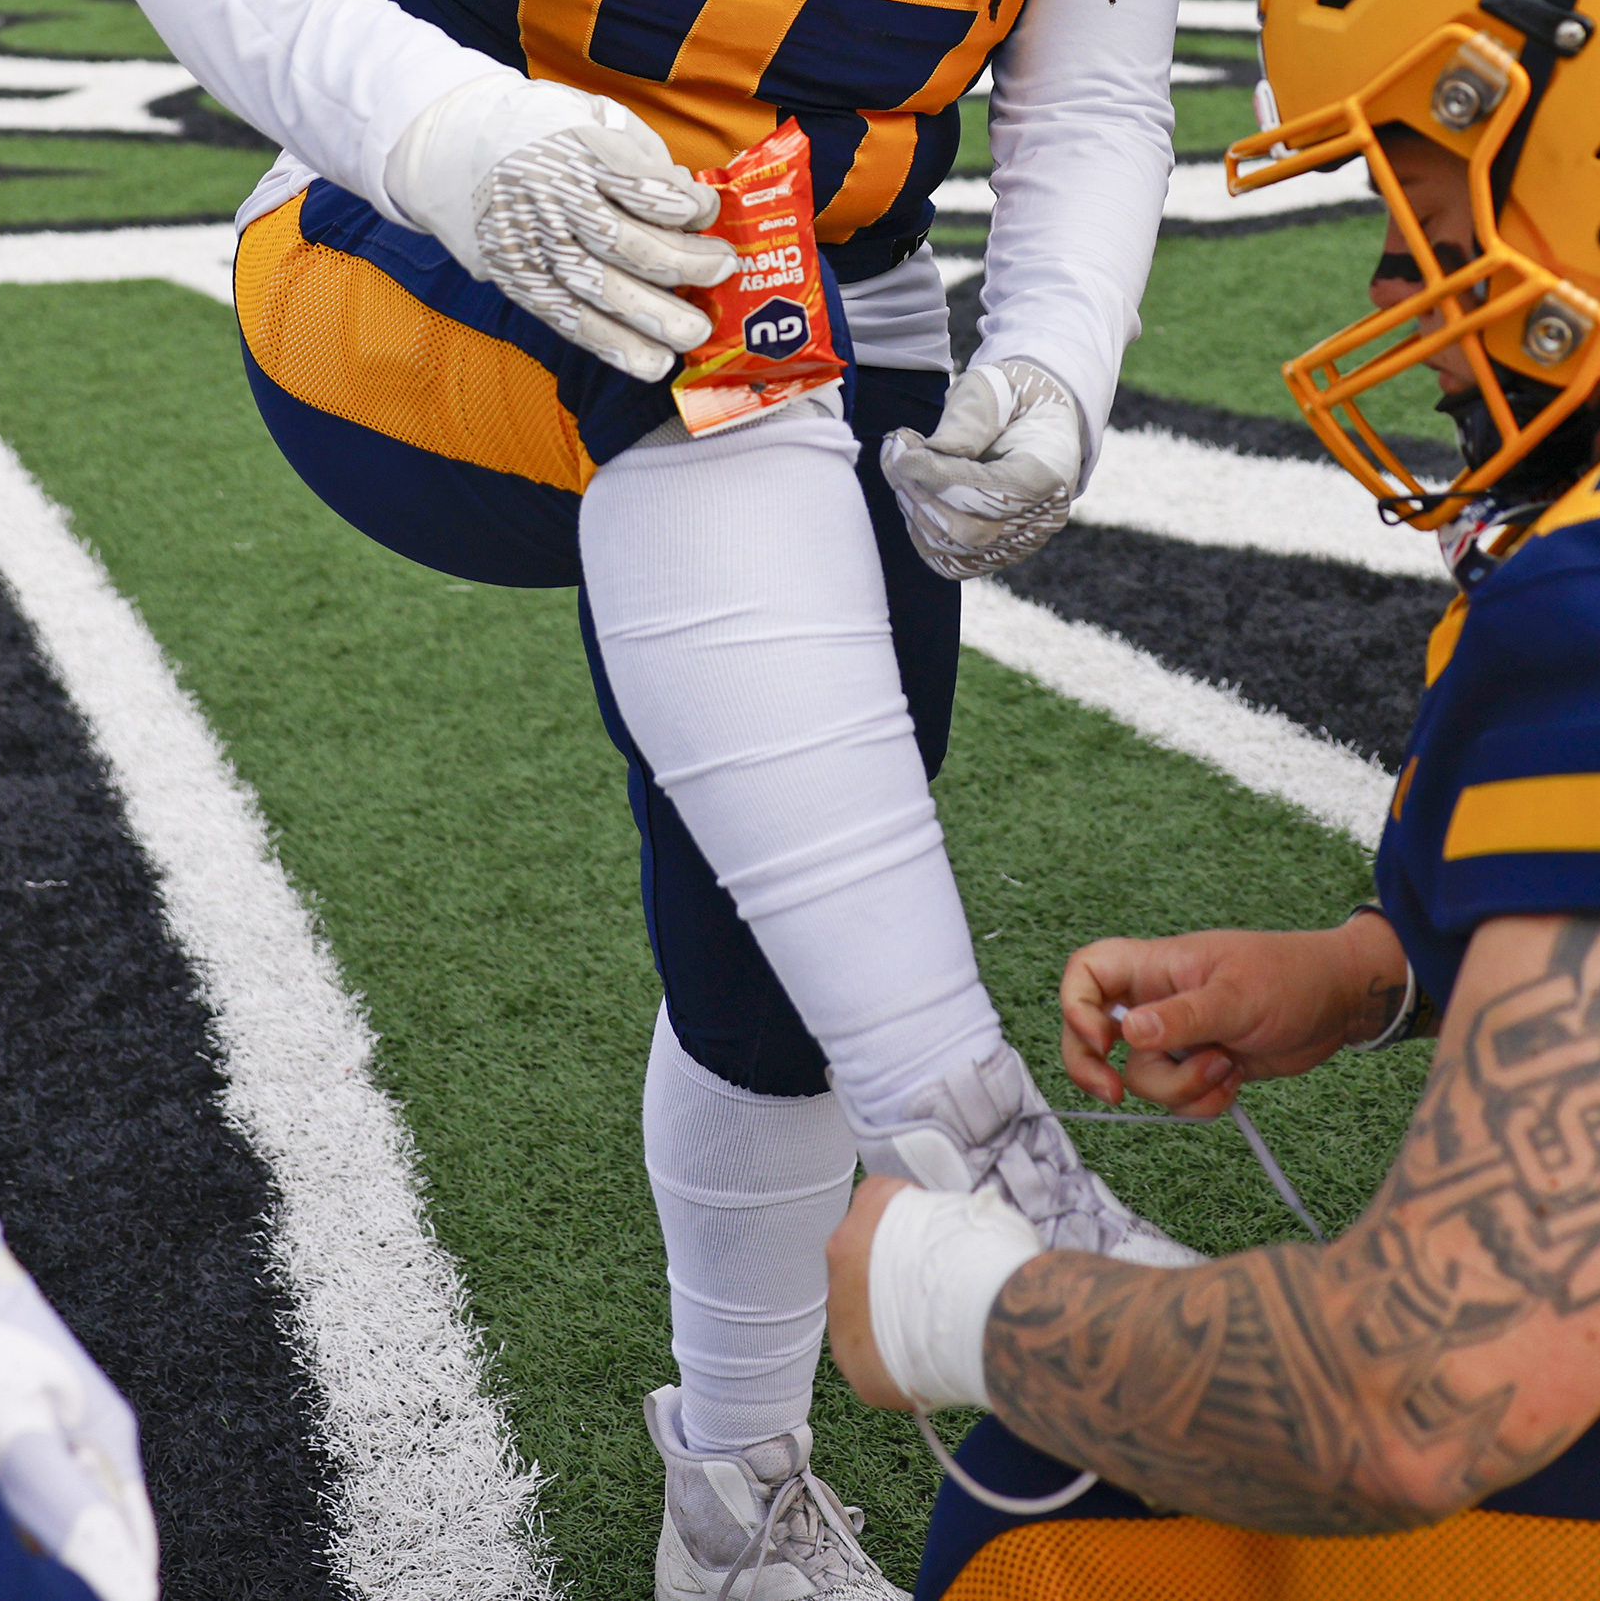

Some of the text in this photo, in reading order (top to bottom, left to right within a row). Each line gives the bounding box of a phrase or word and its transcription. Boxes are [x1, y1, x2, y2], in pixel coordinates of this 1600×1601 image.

[757, 215, 798, 232] Orange
[738, 266, 805, 292] Energy
[750, 315, 803, 347] GU
